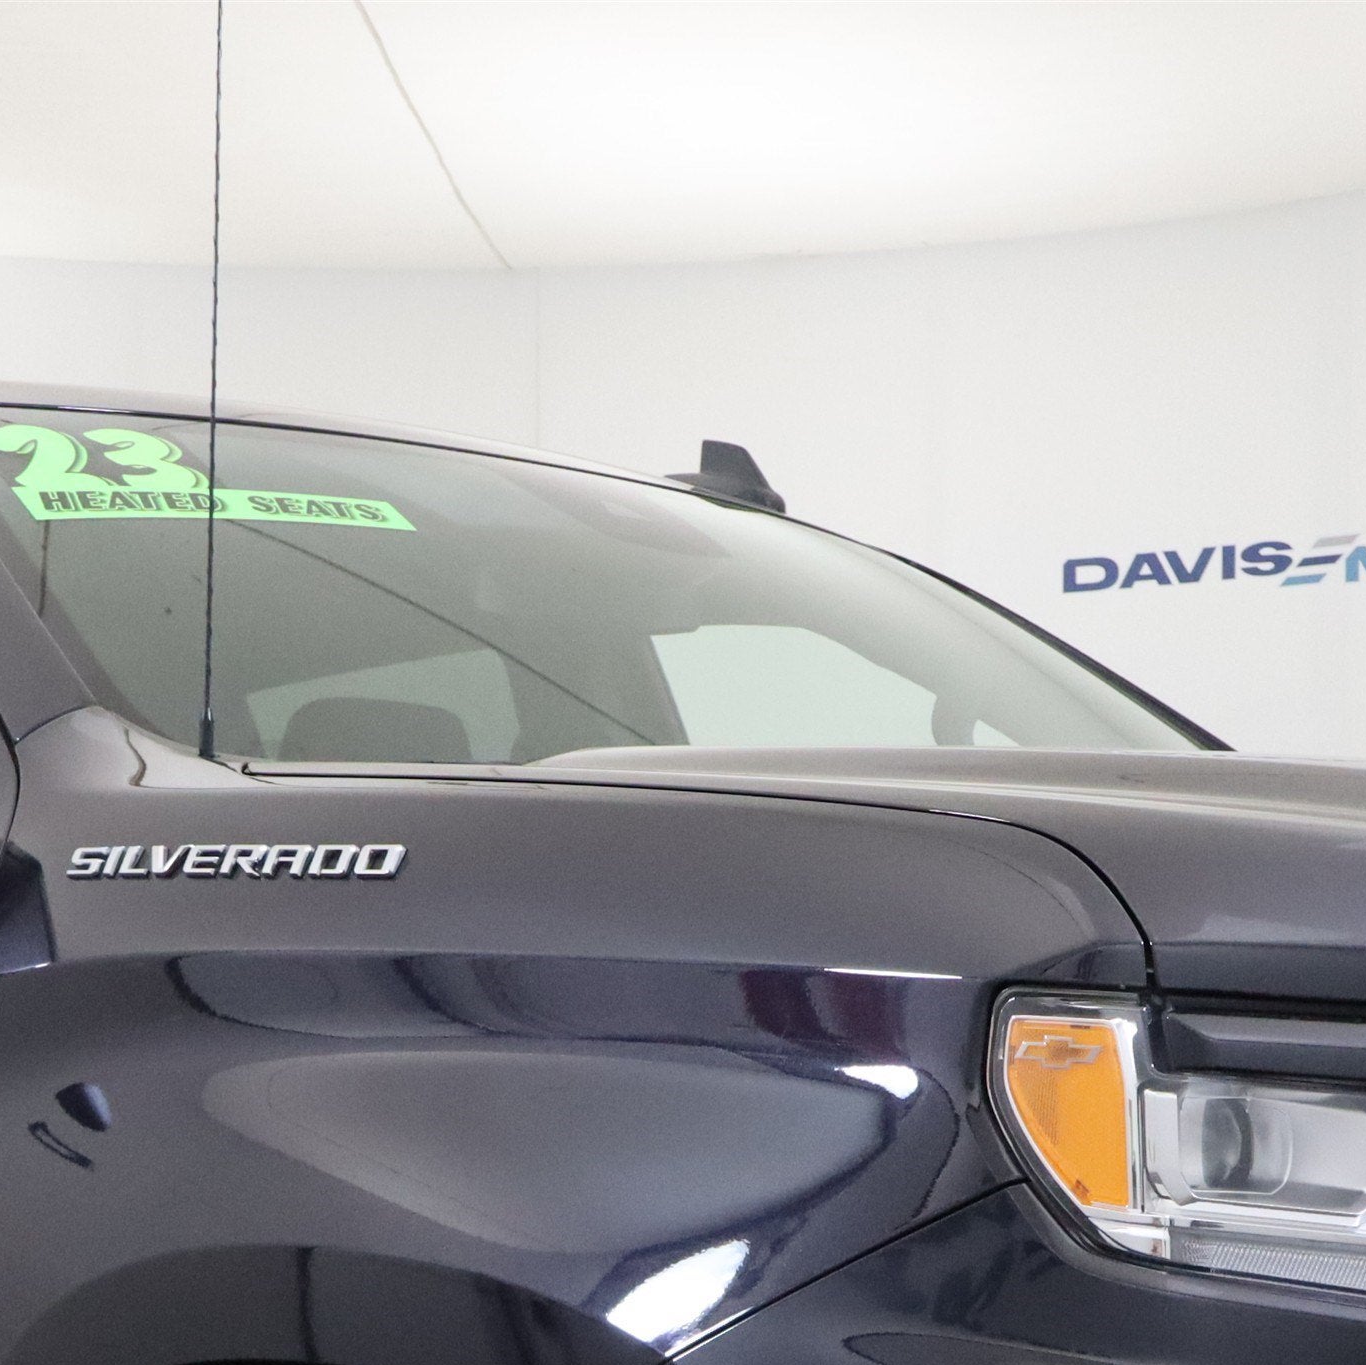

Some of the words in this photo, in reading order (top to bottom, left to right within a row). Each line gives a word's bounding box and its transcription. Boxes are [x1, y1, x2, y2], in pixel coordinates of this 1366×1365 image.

[39, 490, 222, 514] HEATED
[252, 495, 386, 522] SEATS
[1062, 541, 1293, 593] DAVIS
[66, 843, 408, 880] SILVERADO
